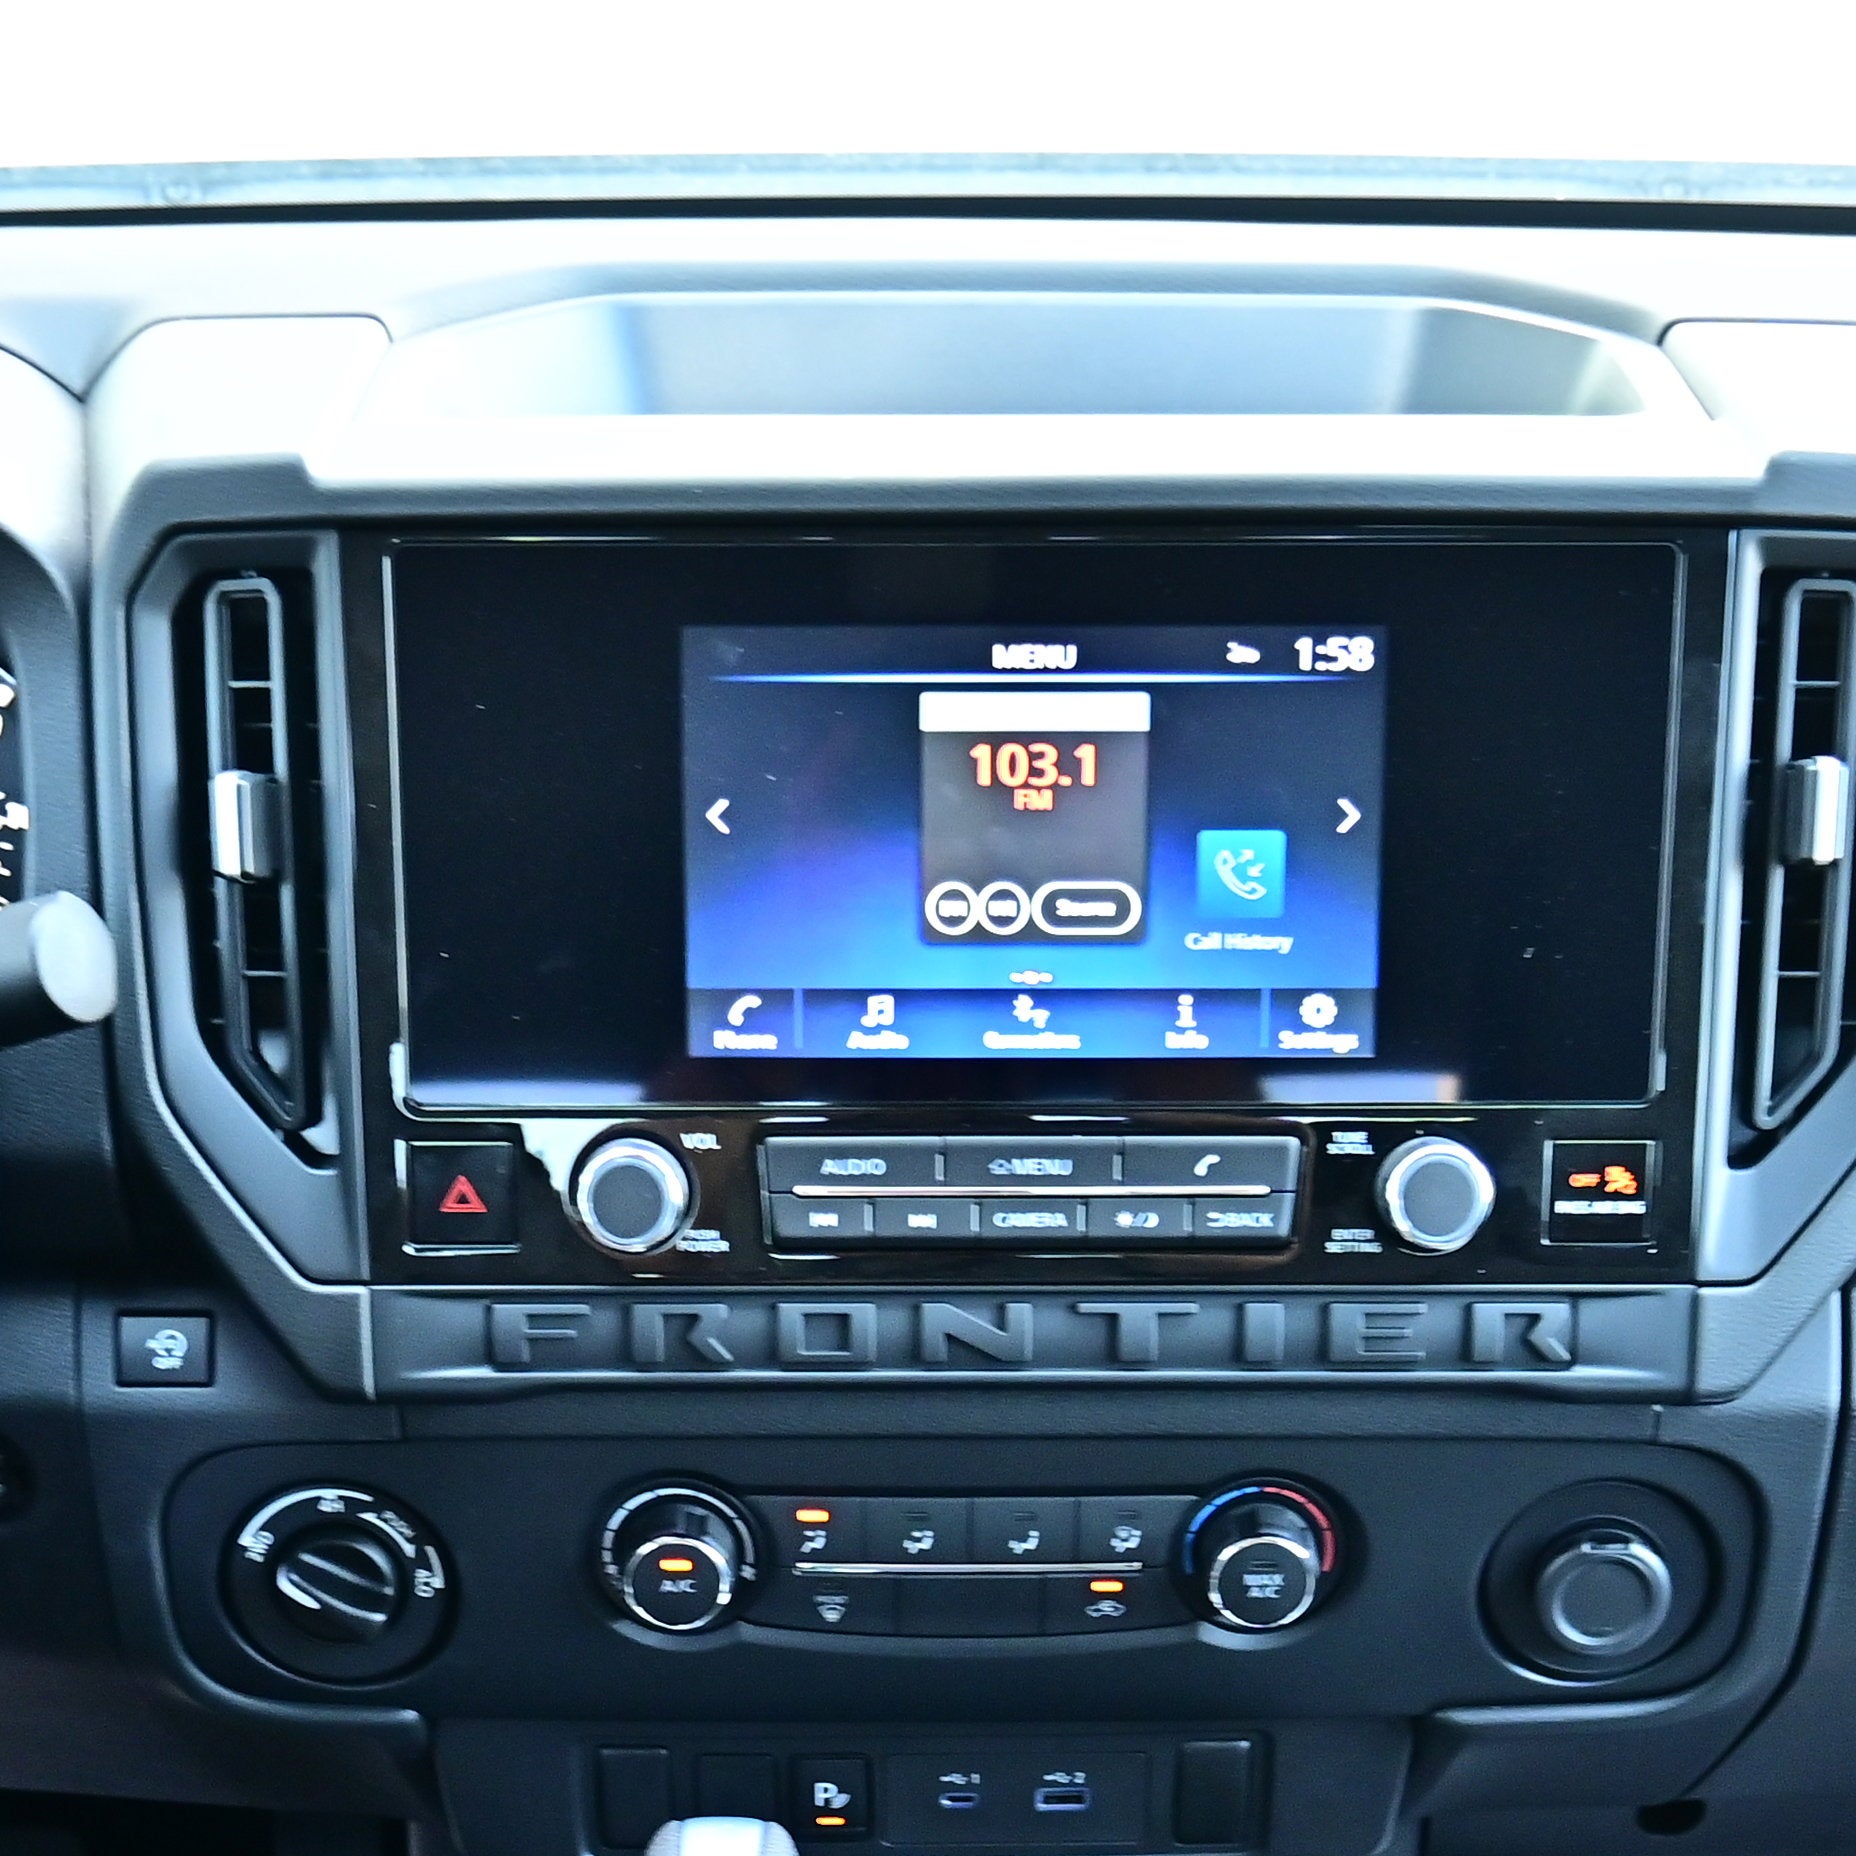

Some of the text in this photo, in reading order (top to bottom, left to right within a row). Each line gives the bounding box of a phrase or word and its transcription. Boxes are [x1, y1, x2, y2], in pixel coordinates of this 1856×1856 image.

[991, 643, 1079, 670] MENU
[1294, 636, 1376, 673] 1:58
[968, 742, 1098, 789] 103.1
[1012, 788, 1055, 812] FM
[819, 1157, 888, 1177] AUDIO
[1010, 1158, 1074, 1177] MENU
[992, 1211, 1069, 1229] CAMERA
[488, 1302, 1573, 1365] FRONTIER
